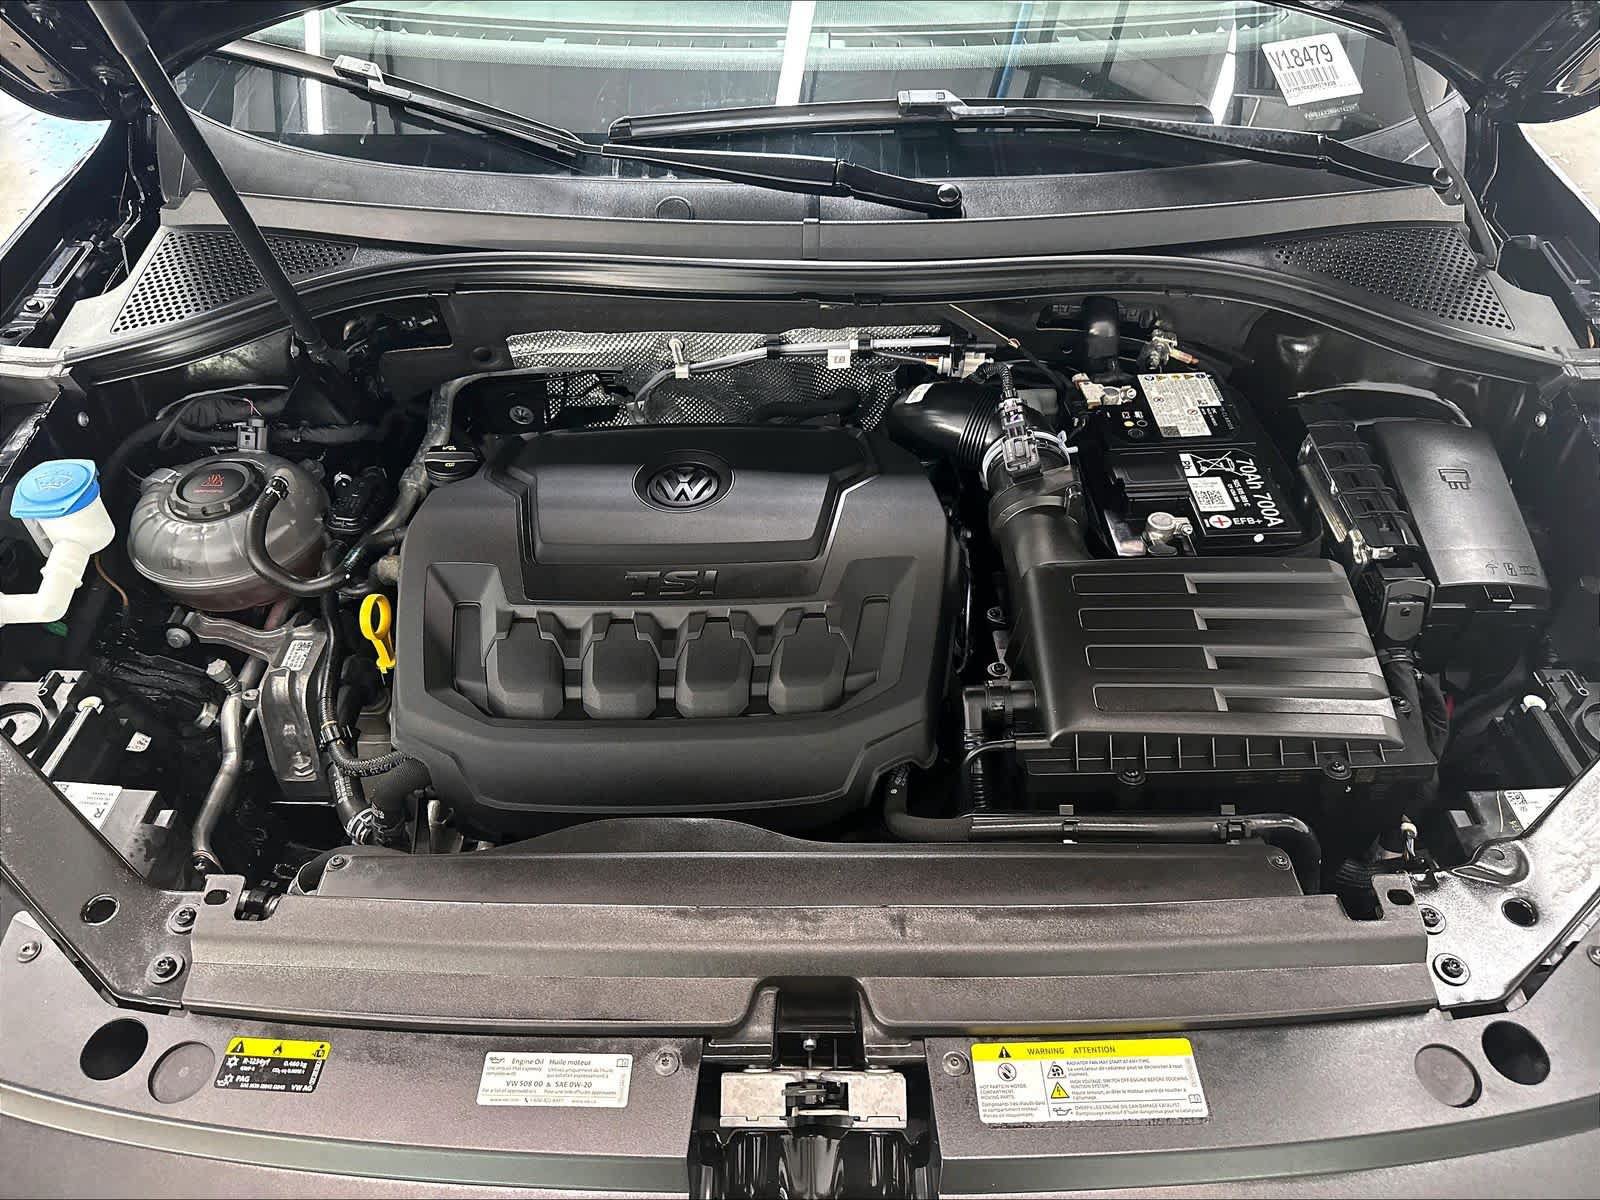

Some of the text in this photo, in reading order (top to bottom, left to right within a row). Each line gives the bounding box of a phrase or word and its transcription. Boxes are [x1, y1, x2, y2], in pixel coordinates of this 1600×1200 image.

[1268, 43, 1333, 71] V18479
[1236, 458, 1284, 528] 70Ah 700A
[625, 570, 718, 596] TSI
[1027, 1045, 1116, 1055] WARNING ATTENTION
[511, 1058, 534, 1066] Engine
[549, 1058, 567, 1066] Huile
[506, 1079, 519, 1087] VW
